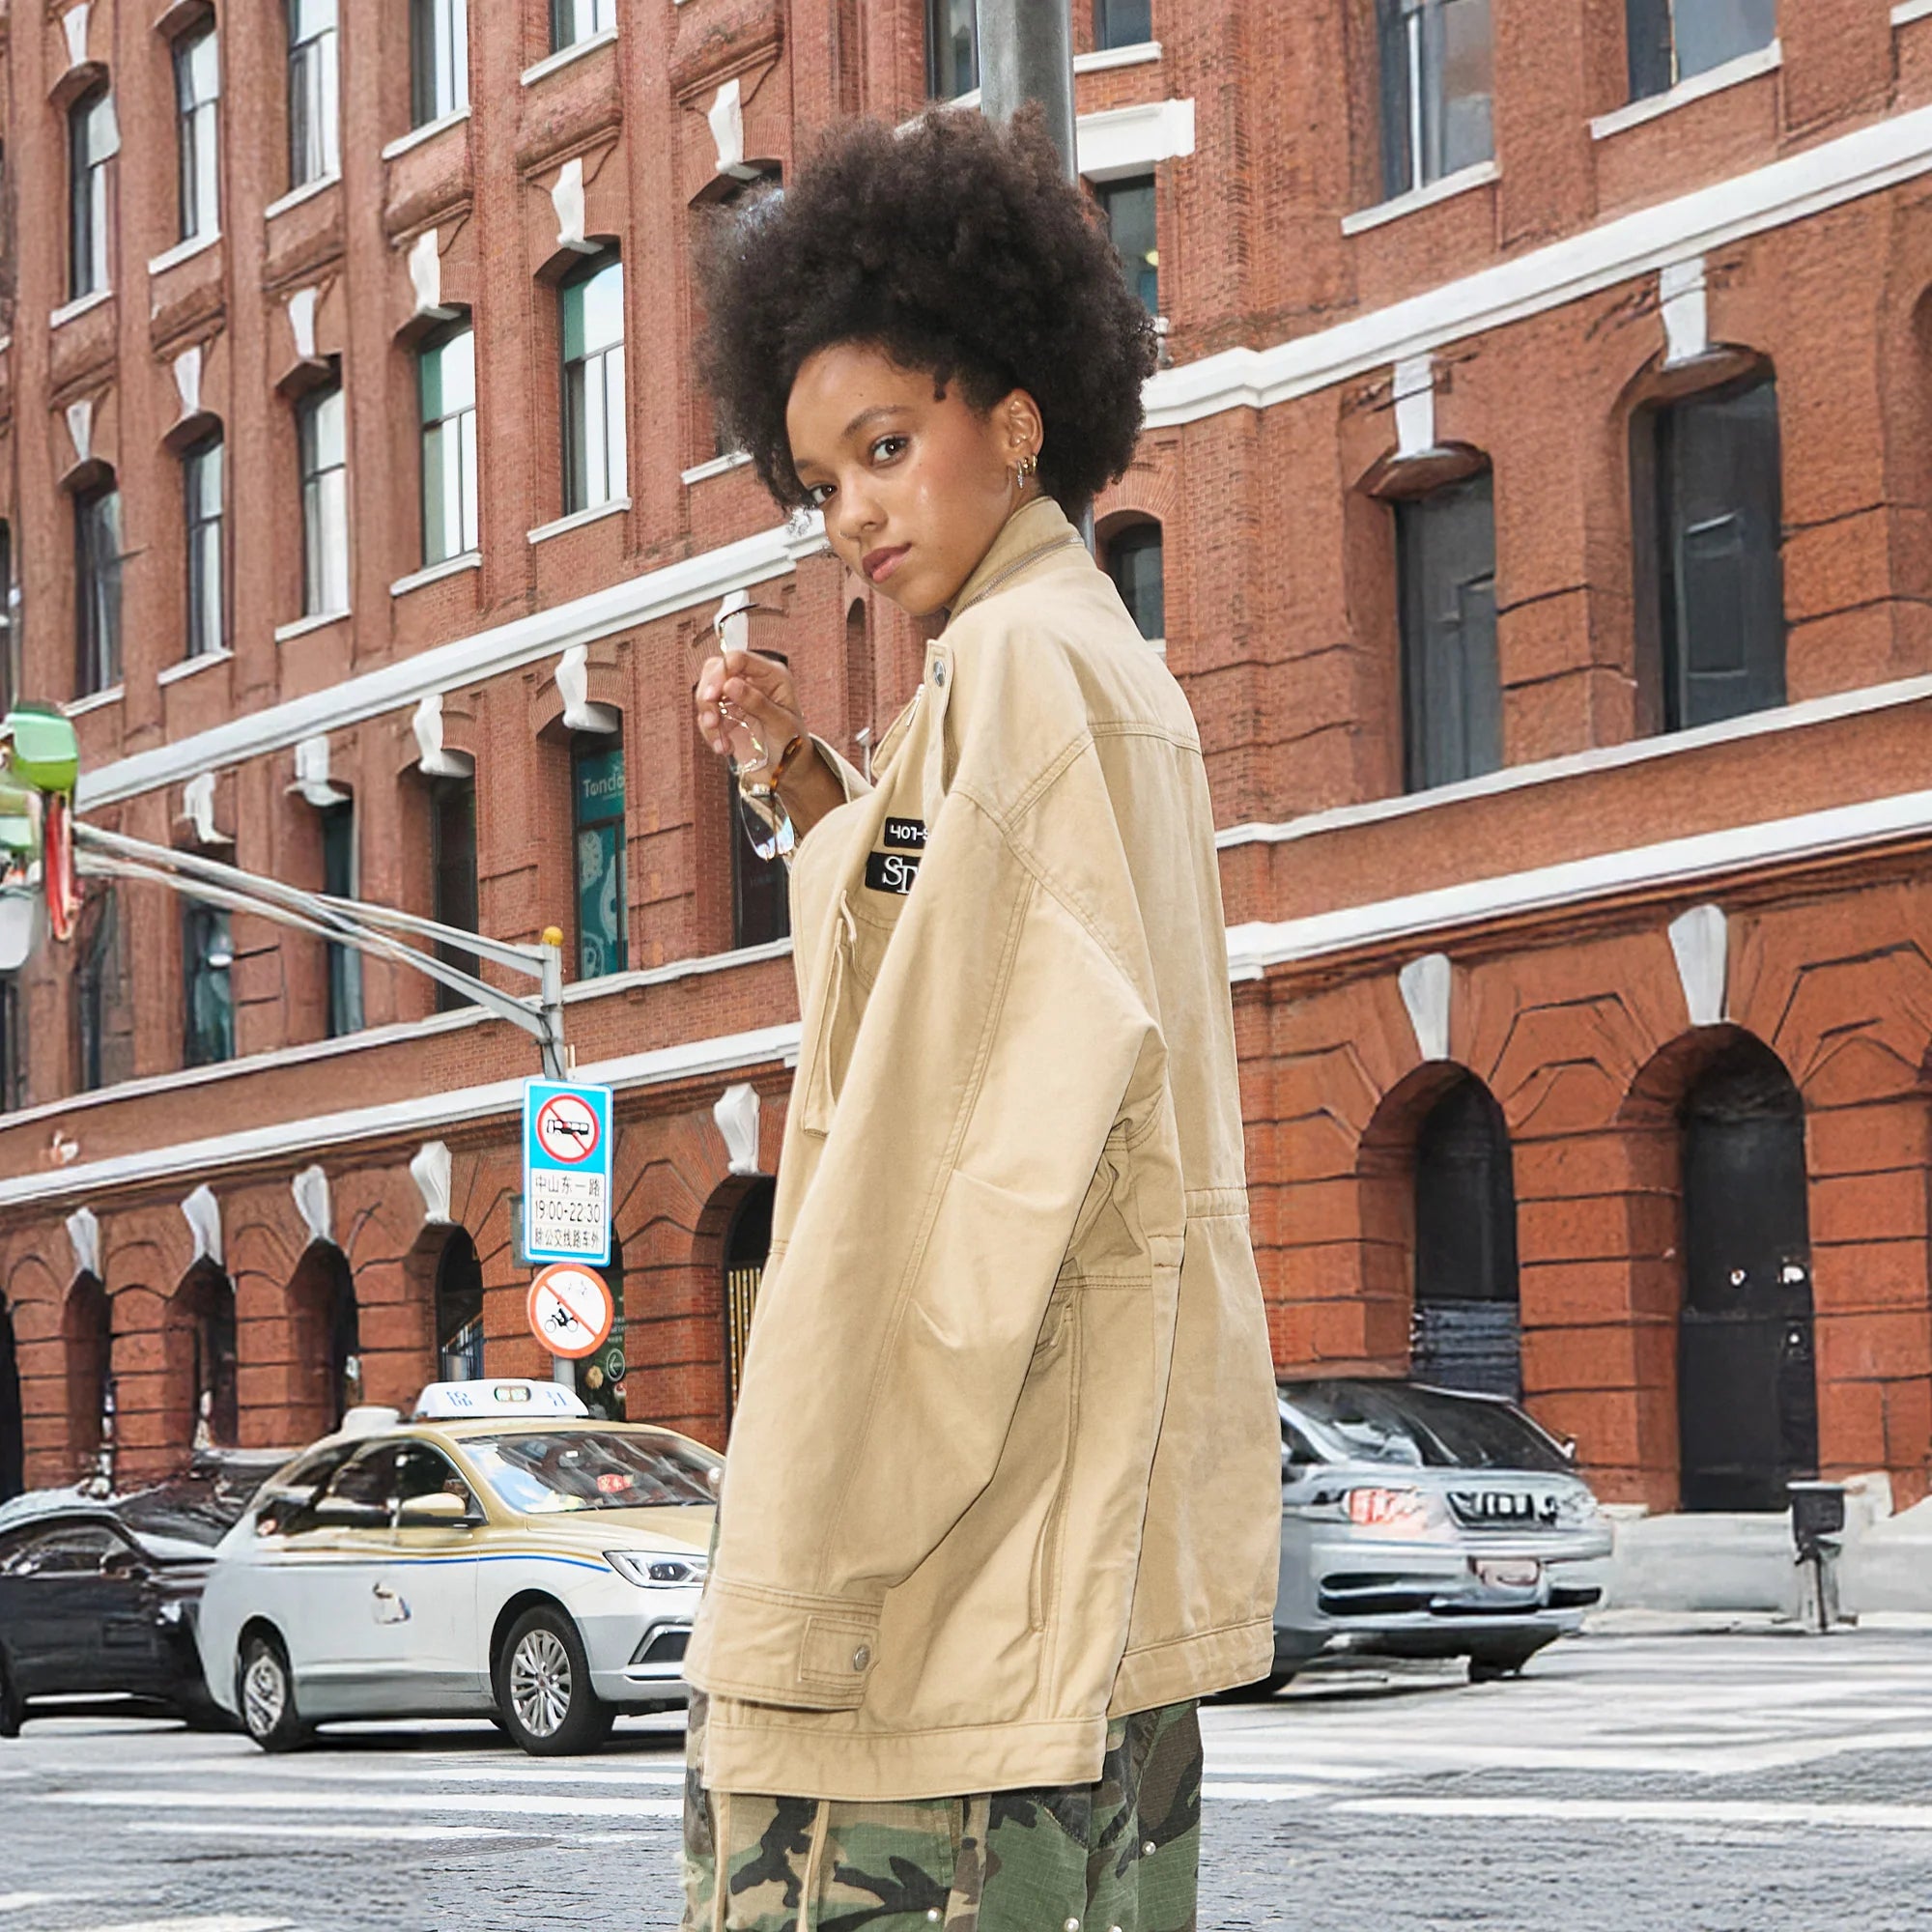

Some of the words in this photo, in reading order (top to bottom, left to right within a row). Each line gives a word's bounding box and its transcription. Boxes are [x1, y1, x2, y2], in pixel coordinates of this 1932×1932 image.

[535, 1175, 600, 1197] 中山东一路
